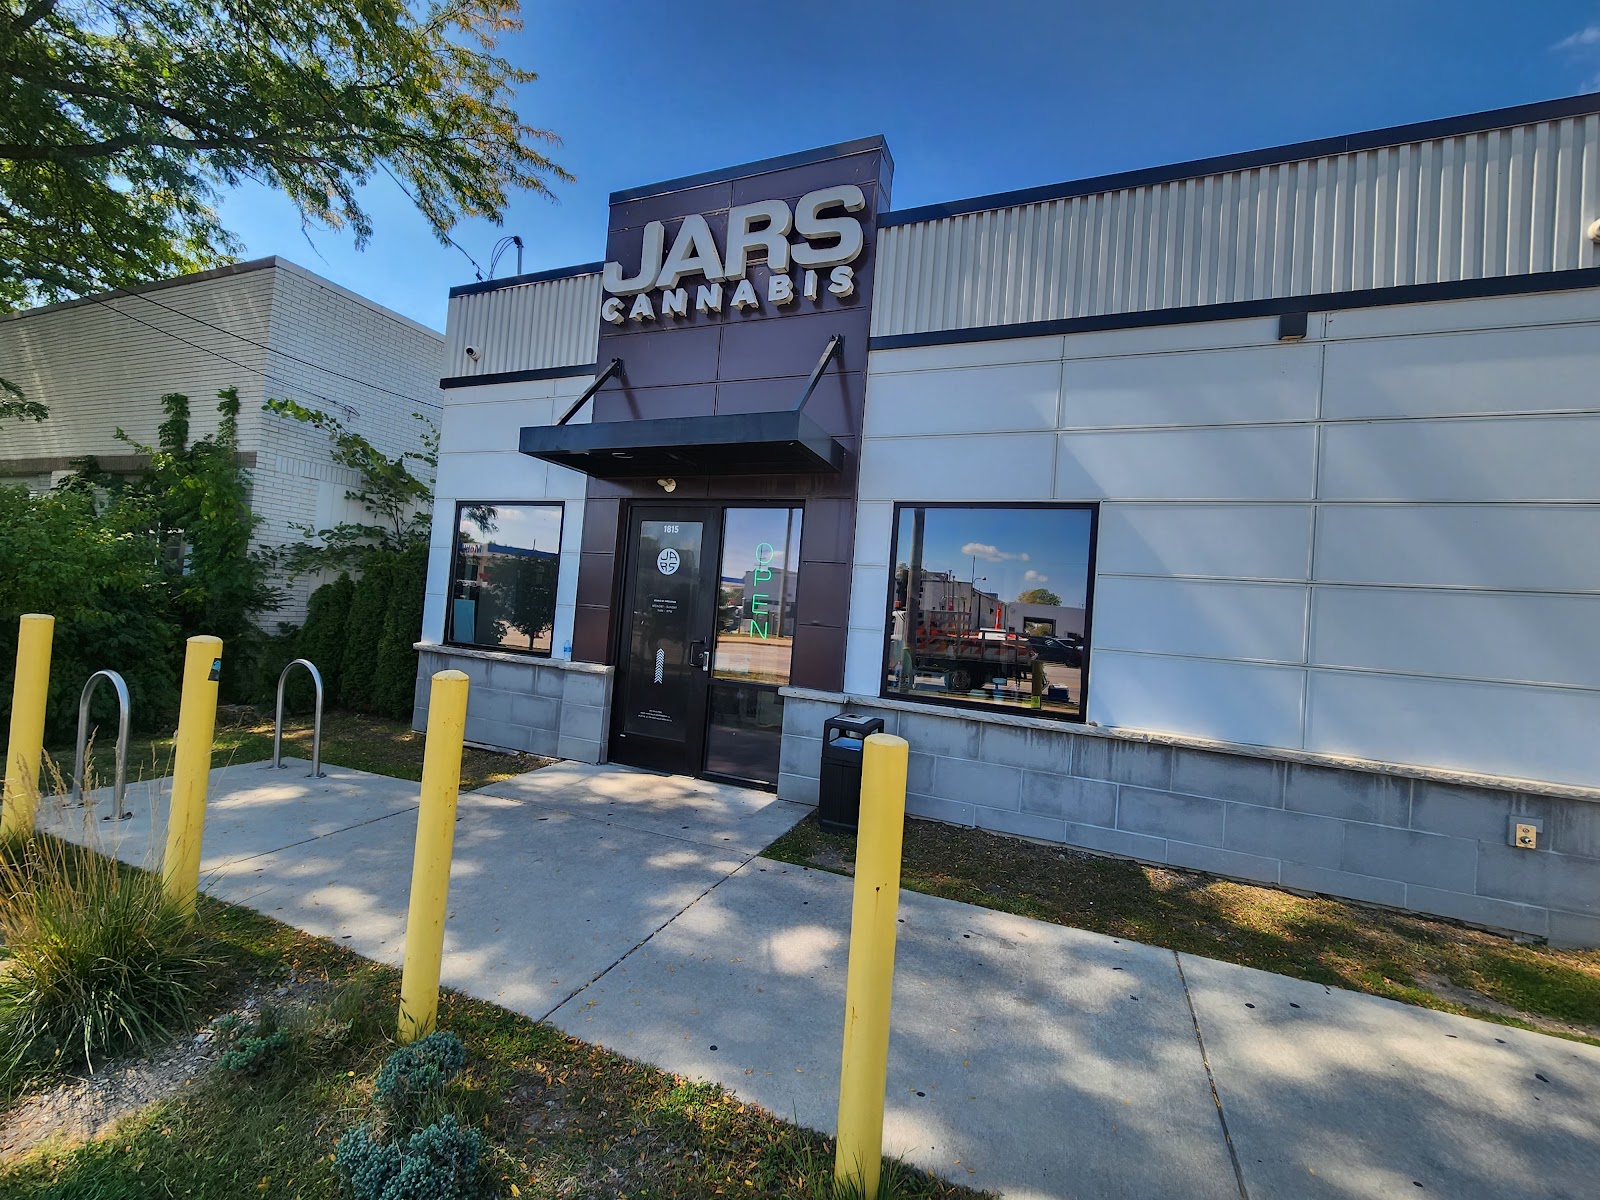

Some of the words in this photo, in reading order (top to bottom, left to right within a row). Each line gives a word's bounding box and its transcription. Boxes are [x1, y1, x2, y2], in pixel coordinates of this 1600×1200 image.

[603, 184, 866, 297] JARS
[601, 265, 855, 325] CANNABIS
[663, 525, 679, 534] 1815
[750, 542, 775, 640] OPEN
